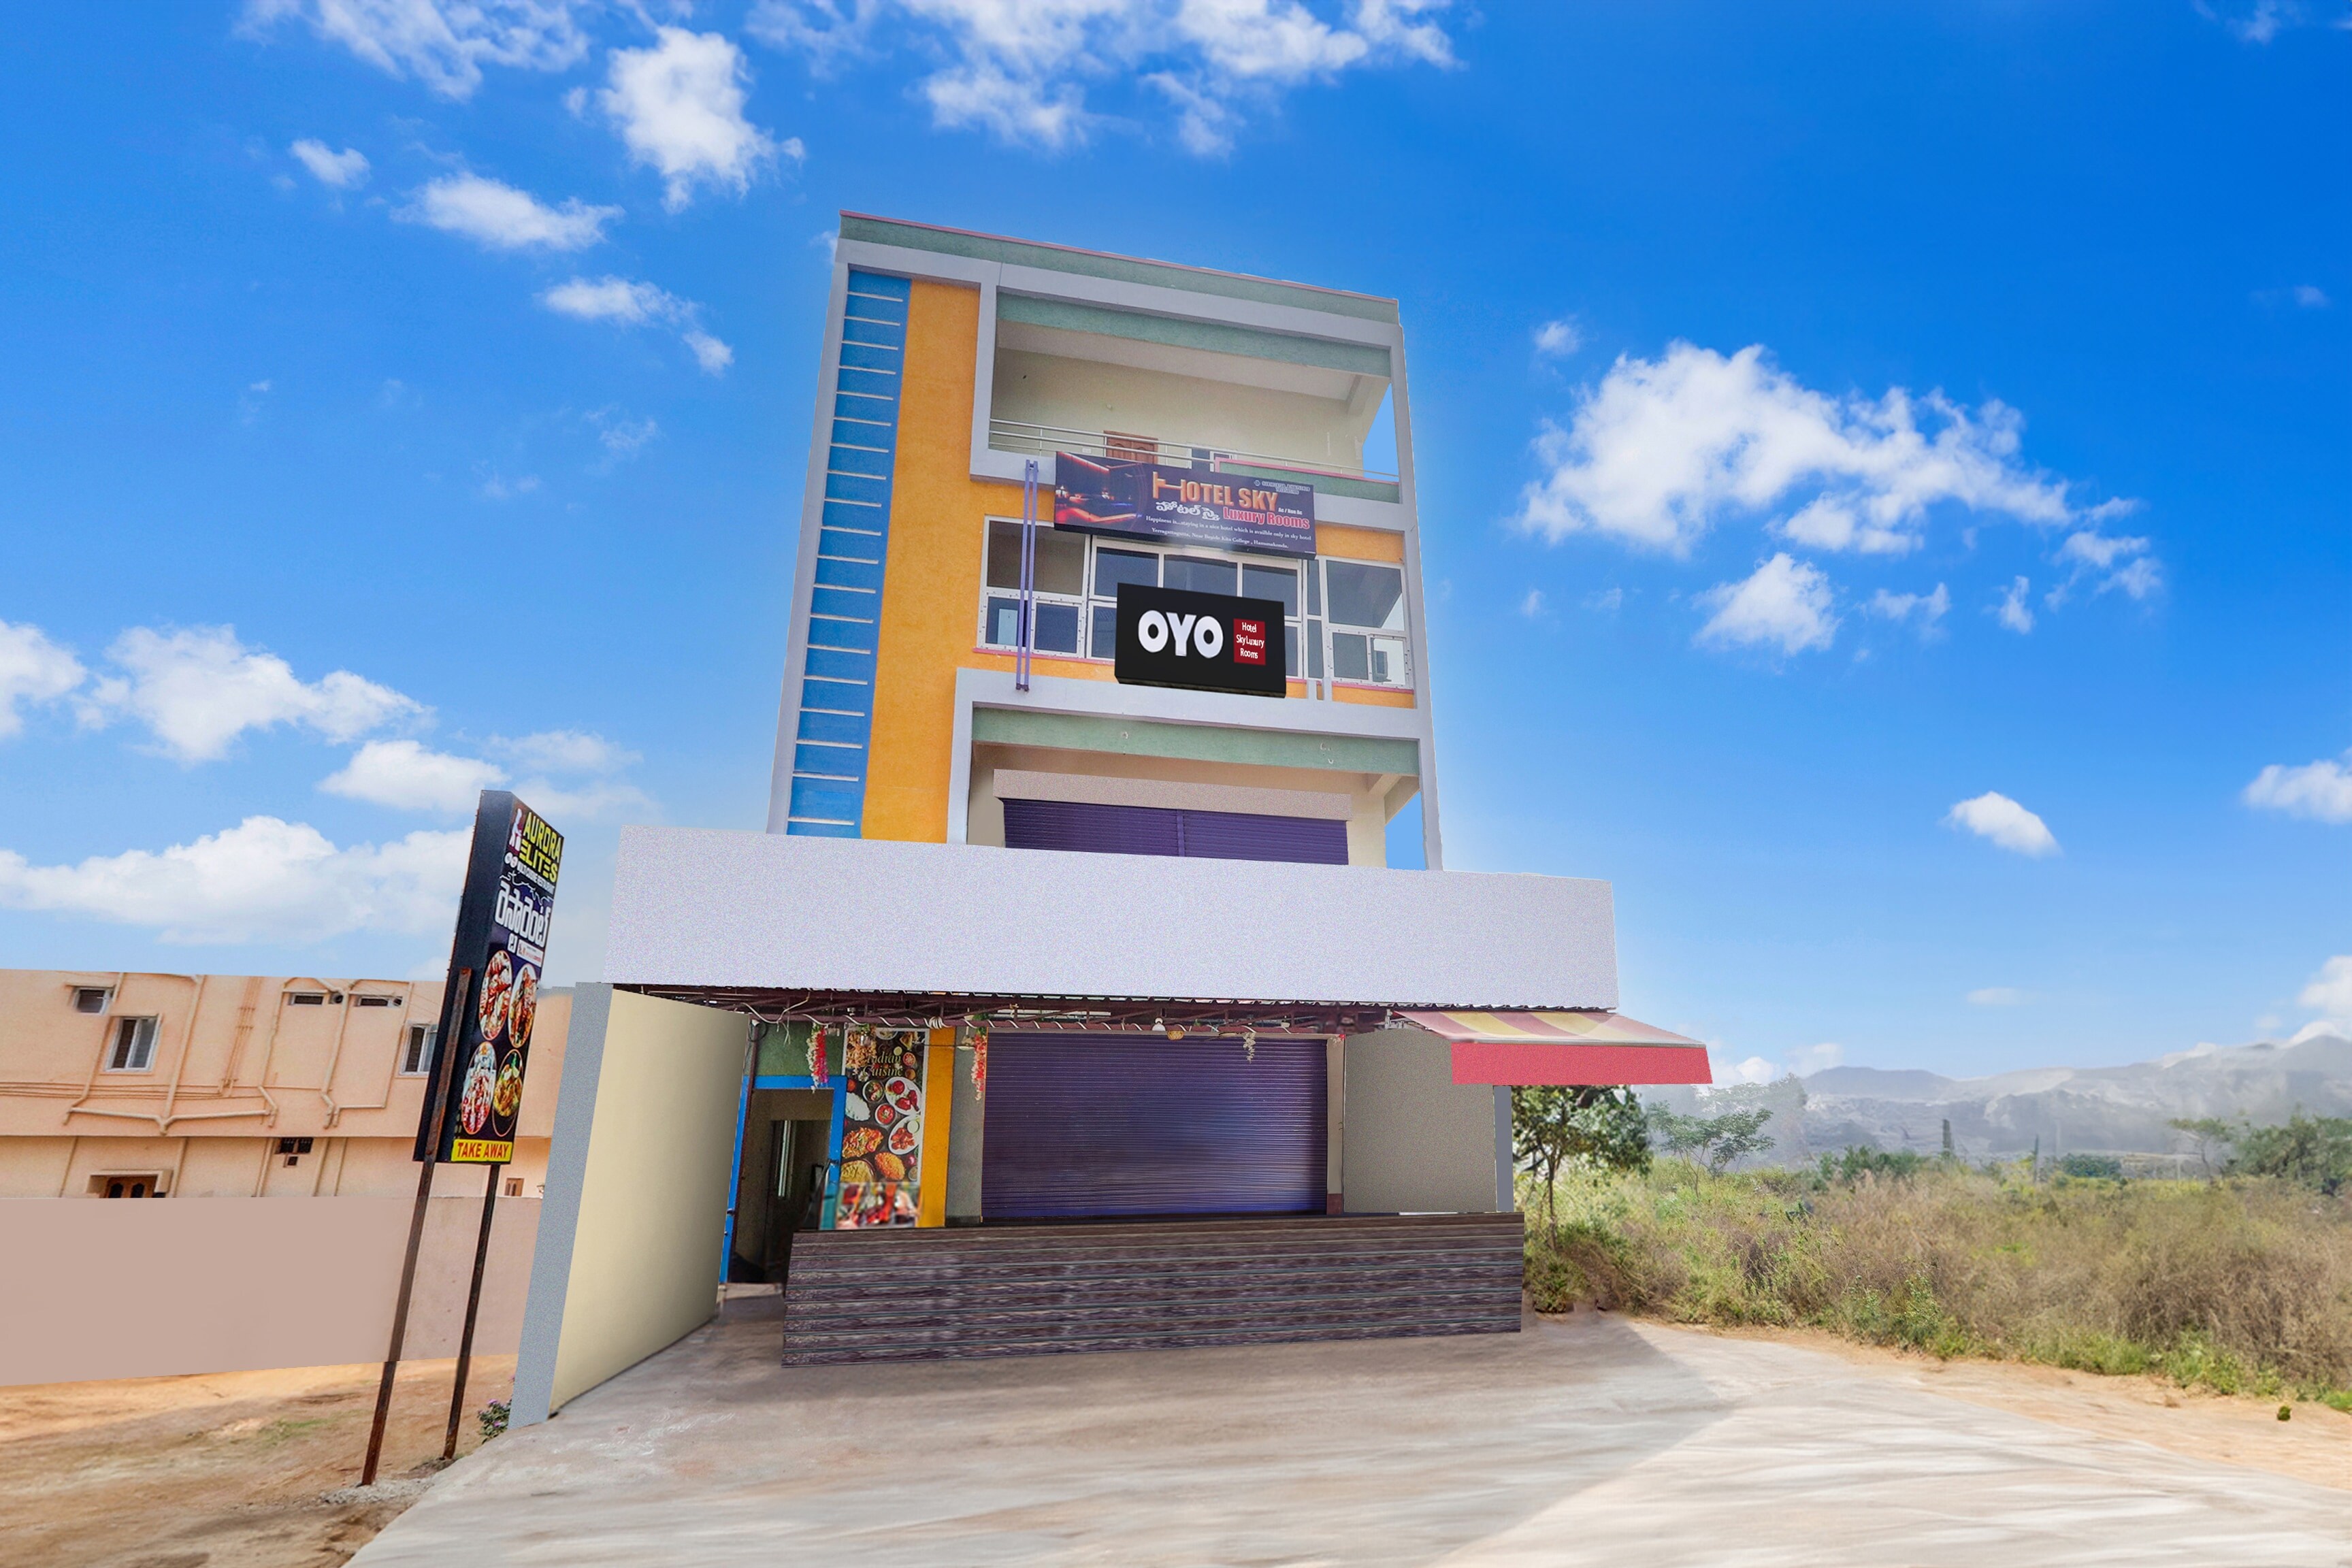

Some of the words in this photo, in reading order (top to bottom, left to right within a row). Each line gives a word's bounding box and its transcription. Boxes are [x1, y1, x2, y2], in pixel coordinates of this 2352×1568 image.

[1152, 471, 1235, 506] HOTEL
[1238, 487, 1279, 512] SKY
[1145, 515, 1171, 523] Happiness
[1223, 506, 1264, 525] Luxury
[1267, 511, 1310, 529] Rooms
[1138, 609, 1224, 659] OYO
[1241, 621, 1257, 633] Hotel
[1240, 647, 1258, 659] Rooms
[523, 811, 561, 864] AURORA
[519, 838, 558, 883] ELITES
[866, 1051, 901, 1064] Indian
[863, 1064, 902, 1077] Cuisine
[457, 1142, 482, 1158] TAKE
[483, 1143, 510, 1158] AWAY
